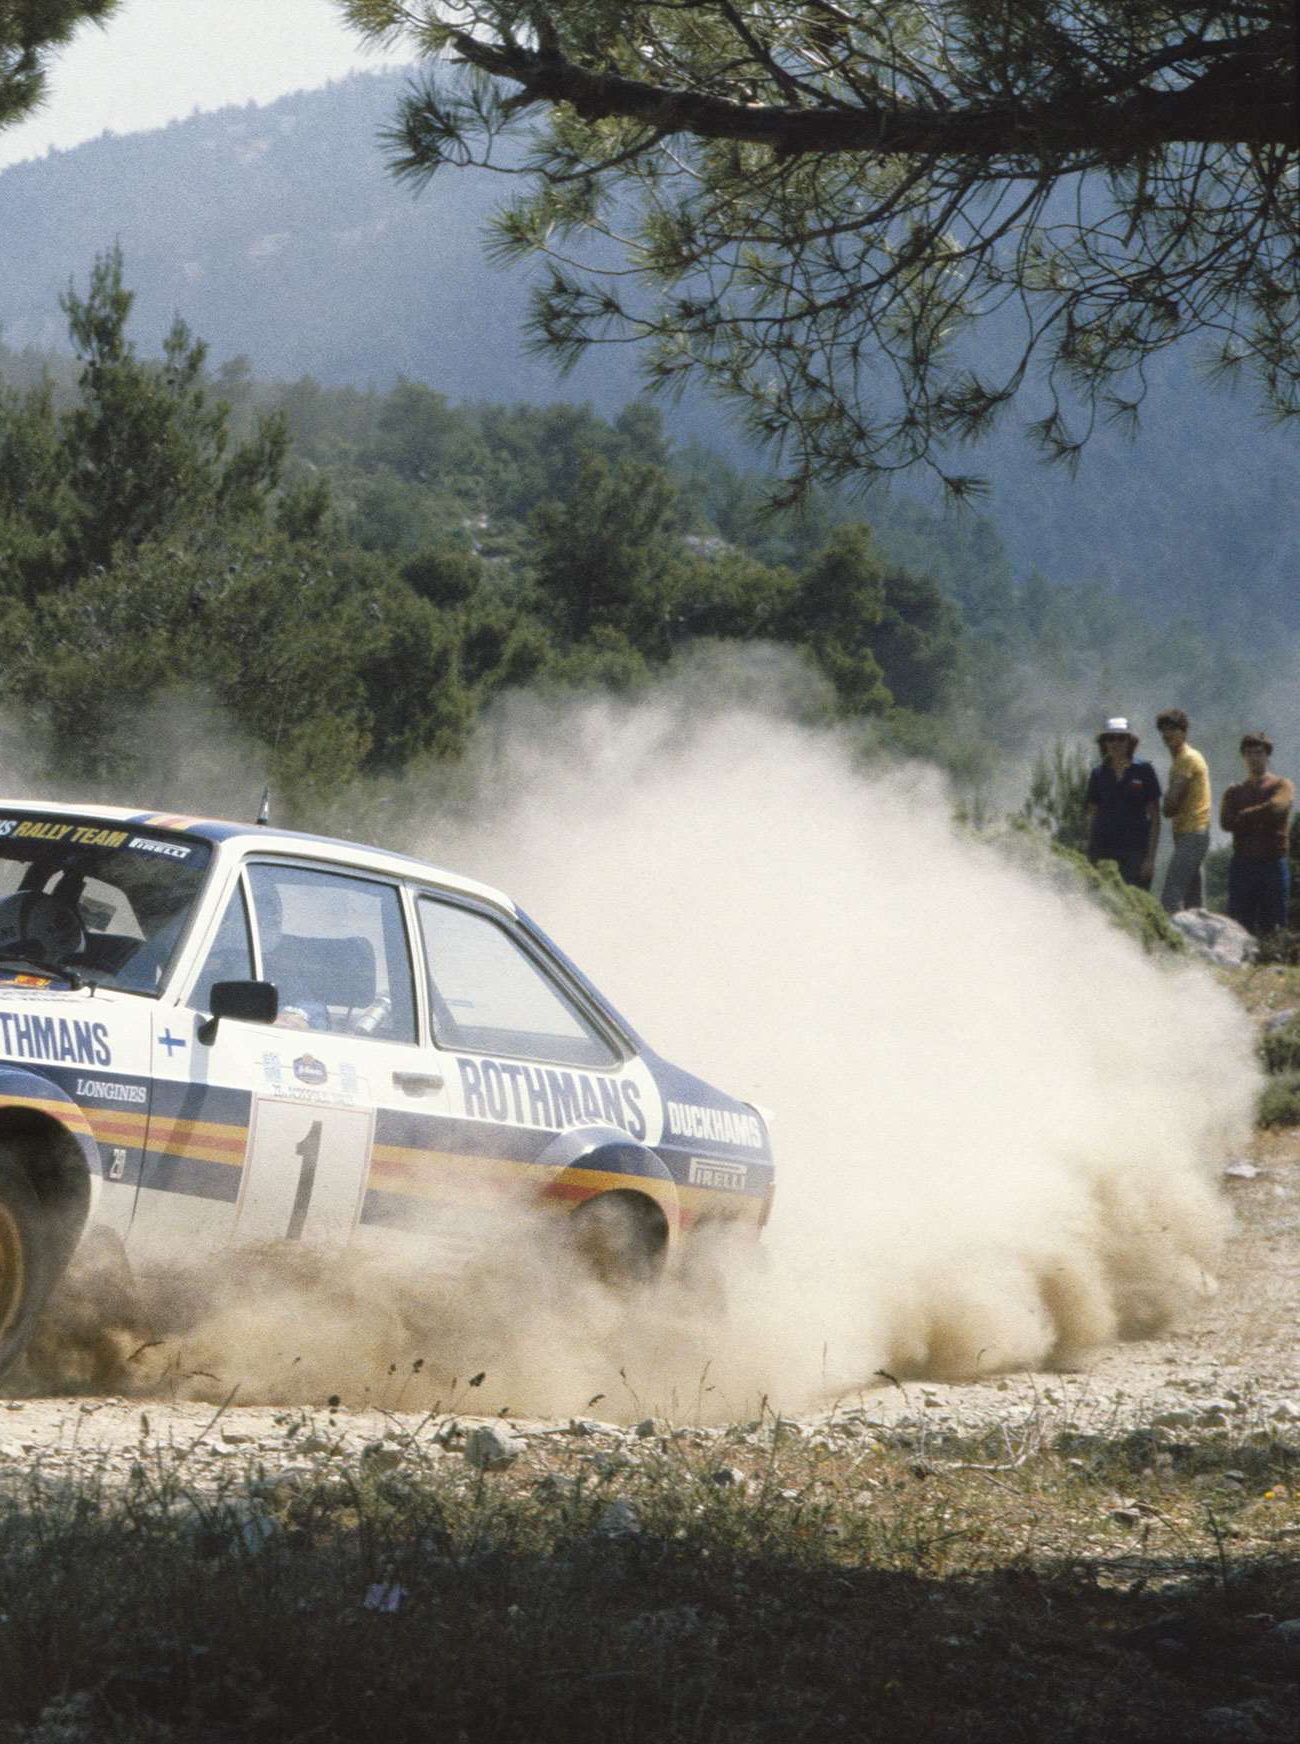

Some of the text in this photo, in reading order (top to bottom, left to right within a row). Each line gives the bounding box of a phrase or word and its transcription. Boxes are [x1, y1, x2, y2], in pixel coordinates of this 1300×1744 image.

[12, 821, 73, 841] RALLY
[70, 826, 129, 848] TEAM
[128, 837, 191, 859] PIRELLI
[76, 1078, 147, 1104] LONGINES
[455, 1056, 647, 1143] ROTHMANS
[666, 1101, 763, 1148] DUCKHAMS
[285, 1120, 322, 1240] 1
[690, 1156, 747, 1190] PIRELLI
